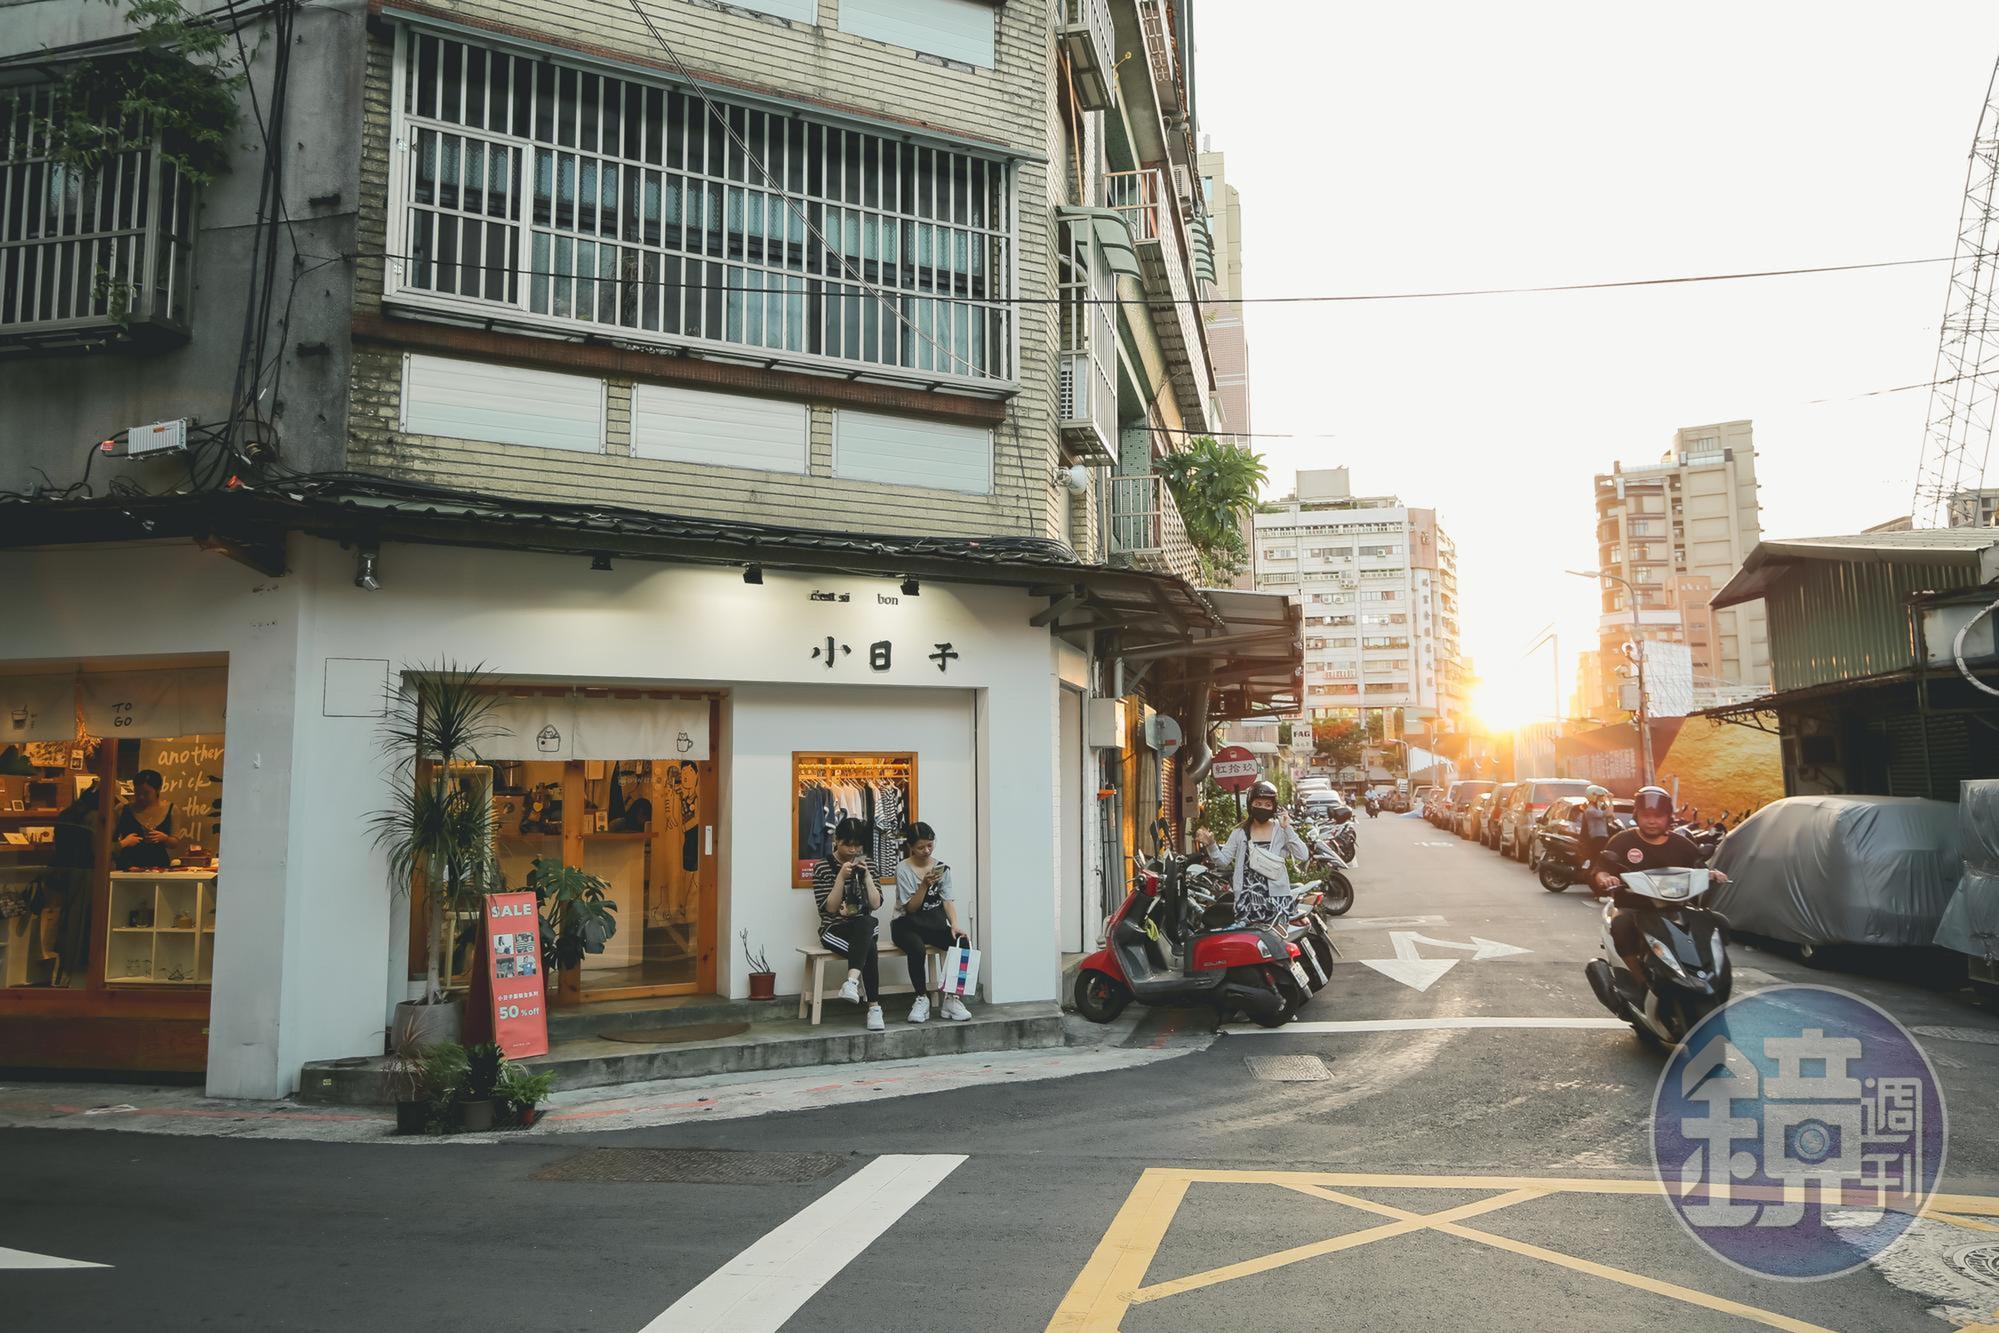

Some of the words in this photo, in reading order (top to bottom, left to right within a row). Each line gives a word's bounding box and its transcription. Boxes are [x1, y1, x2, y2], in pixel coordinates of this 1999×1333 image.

[877, 593, 899, 605] bon
[811, 636, 959, 673] 小日子
[112, 702, 132, 713] TO
[114, 716, 132, 727] GO
[158, 744, 224, 766] another
[160, 771, 212, 792] brick
[182, 796, 213, 817] the
[491, 903, 532, 918] SALE
